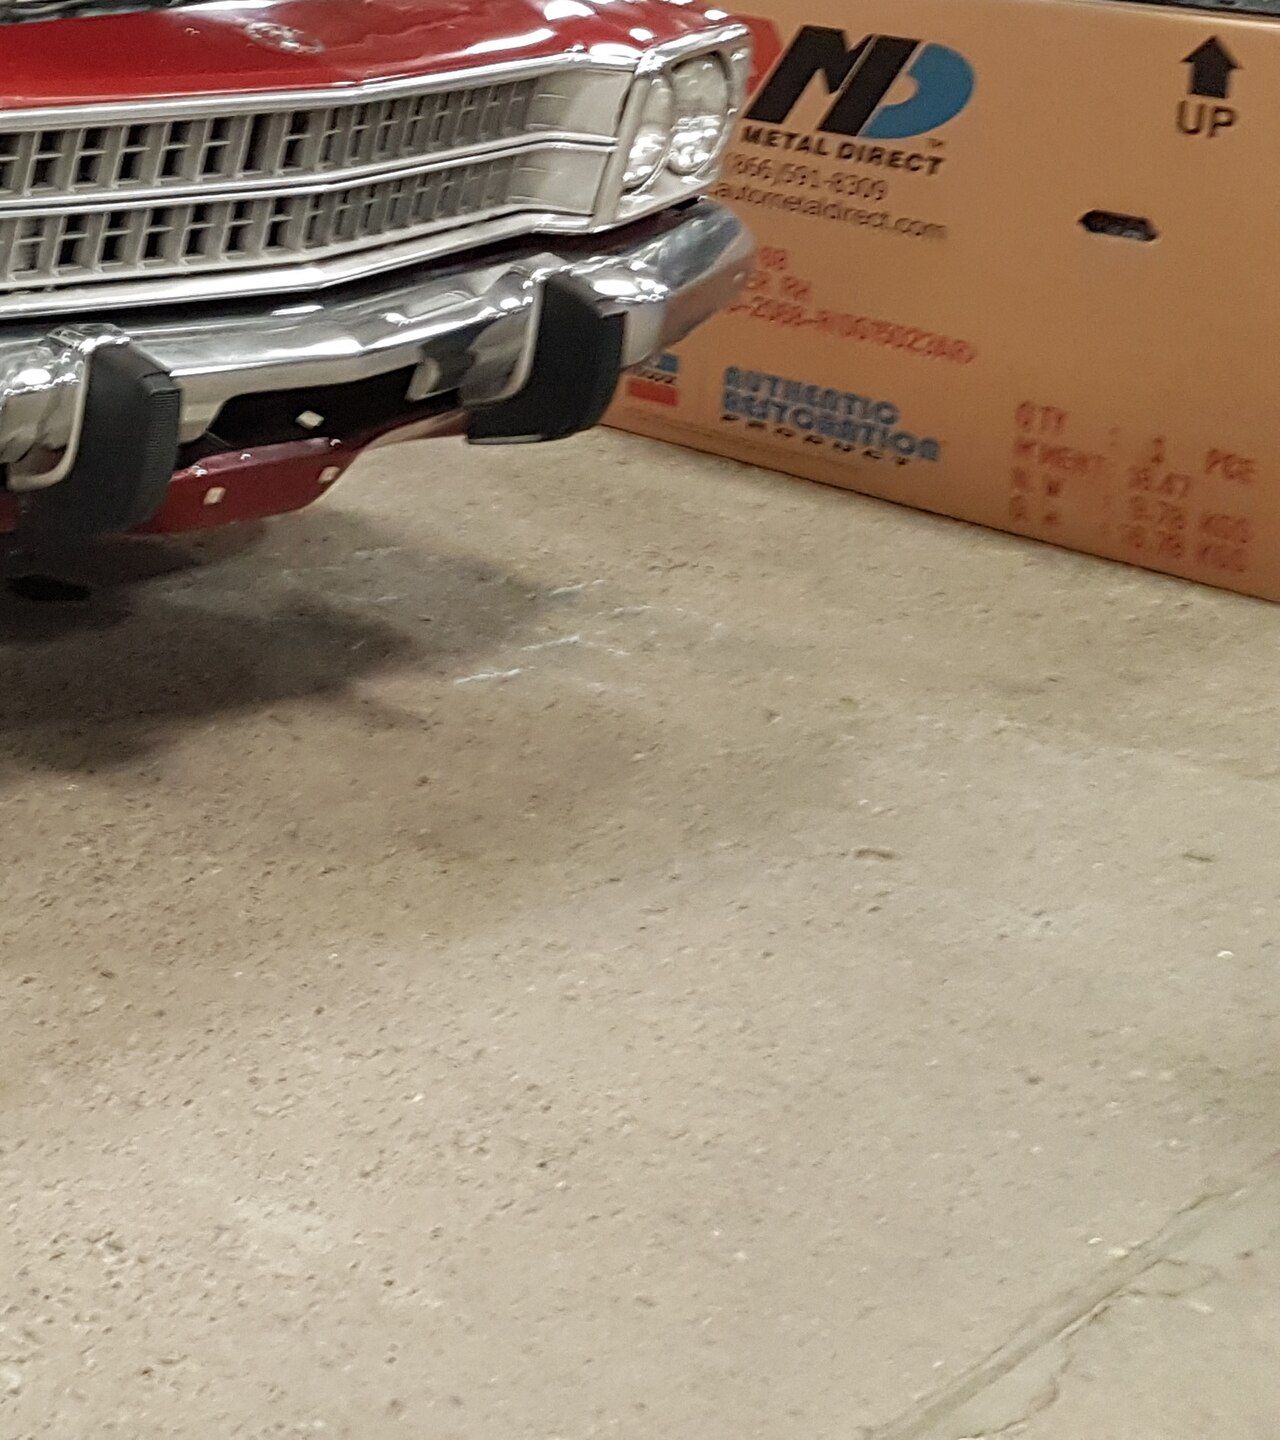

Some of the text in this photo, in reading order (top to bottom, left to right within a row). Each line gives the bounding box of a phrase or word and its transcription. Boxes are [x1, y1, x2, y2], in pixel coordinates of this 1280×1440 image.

[1178, 101, 1235, 138] UP
[743, 126, 944, 176] METAL DIRECT
